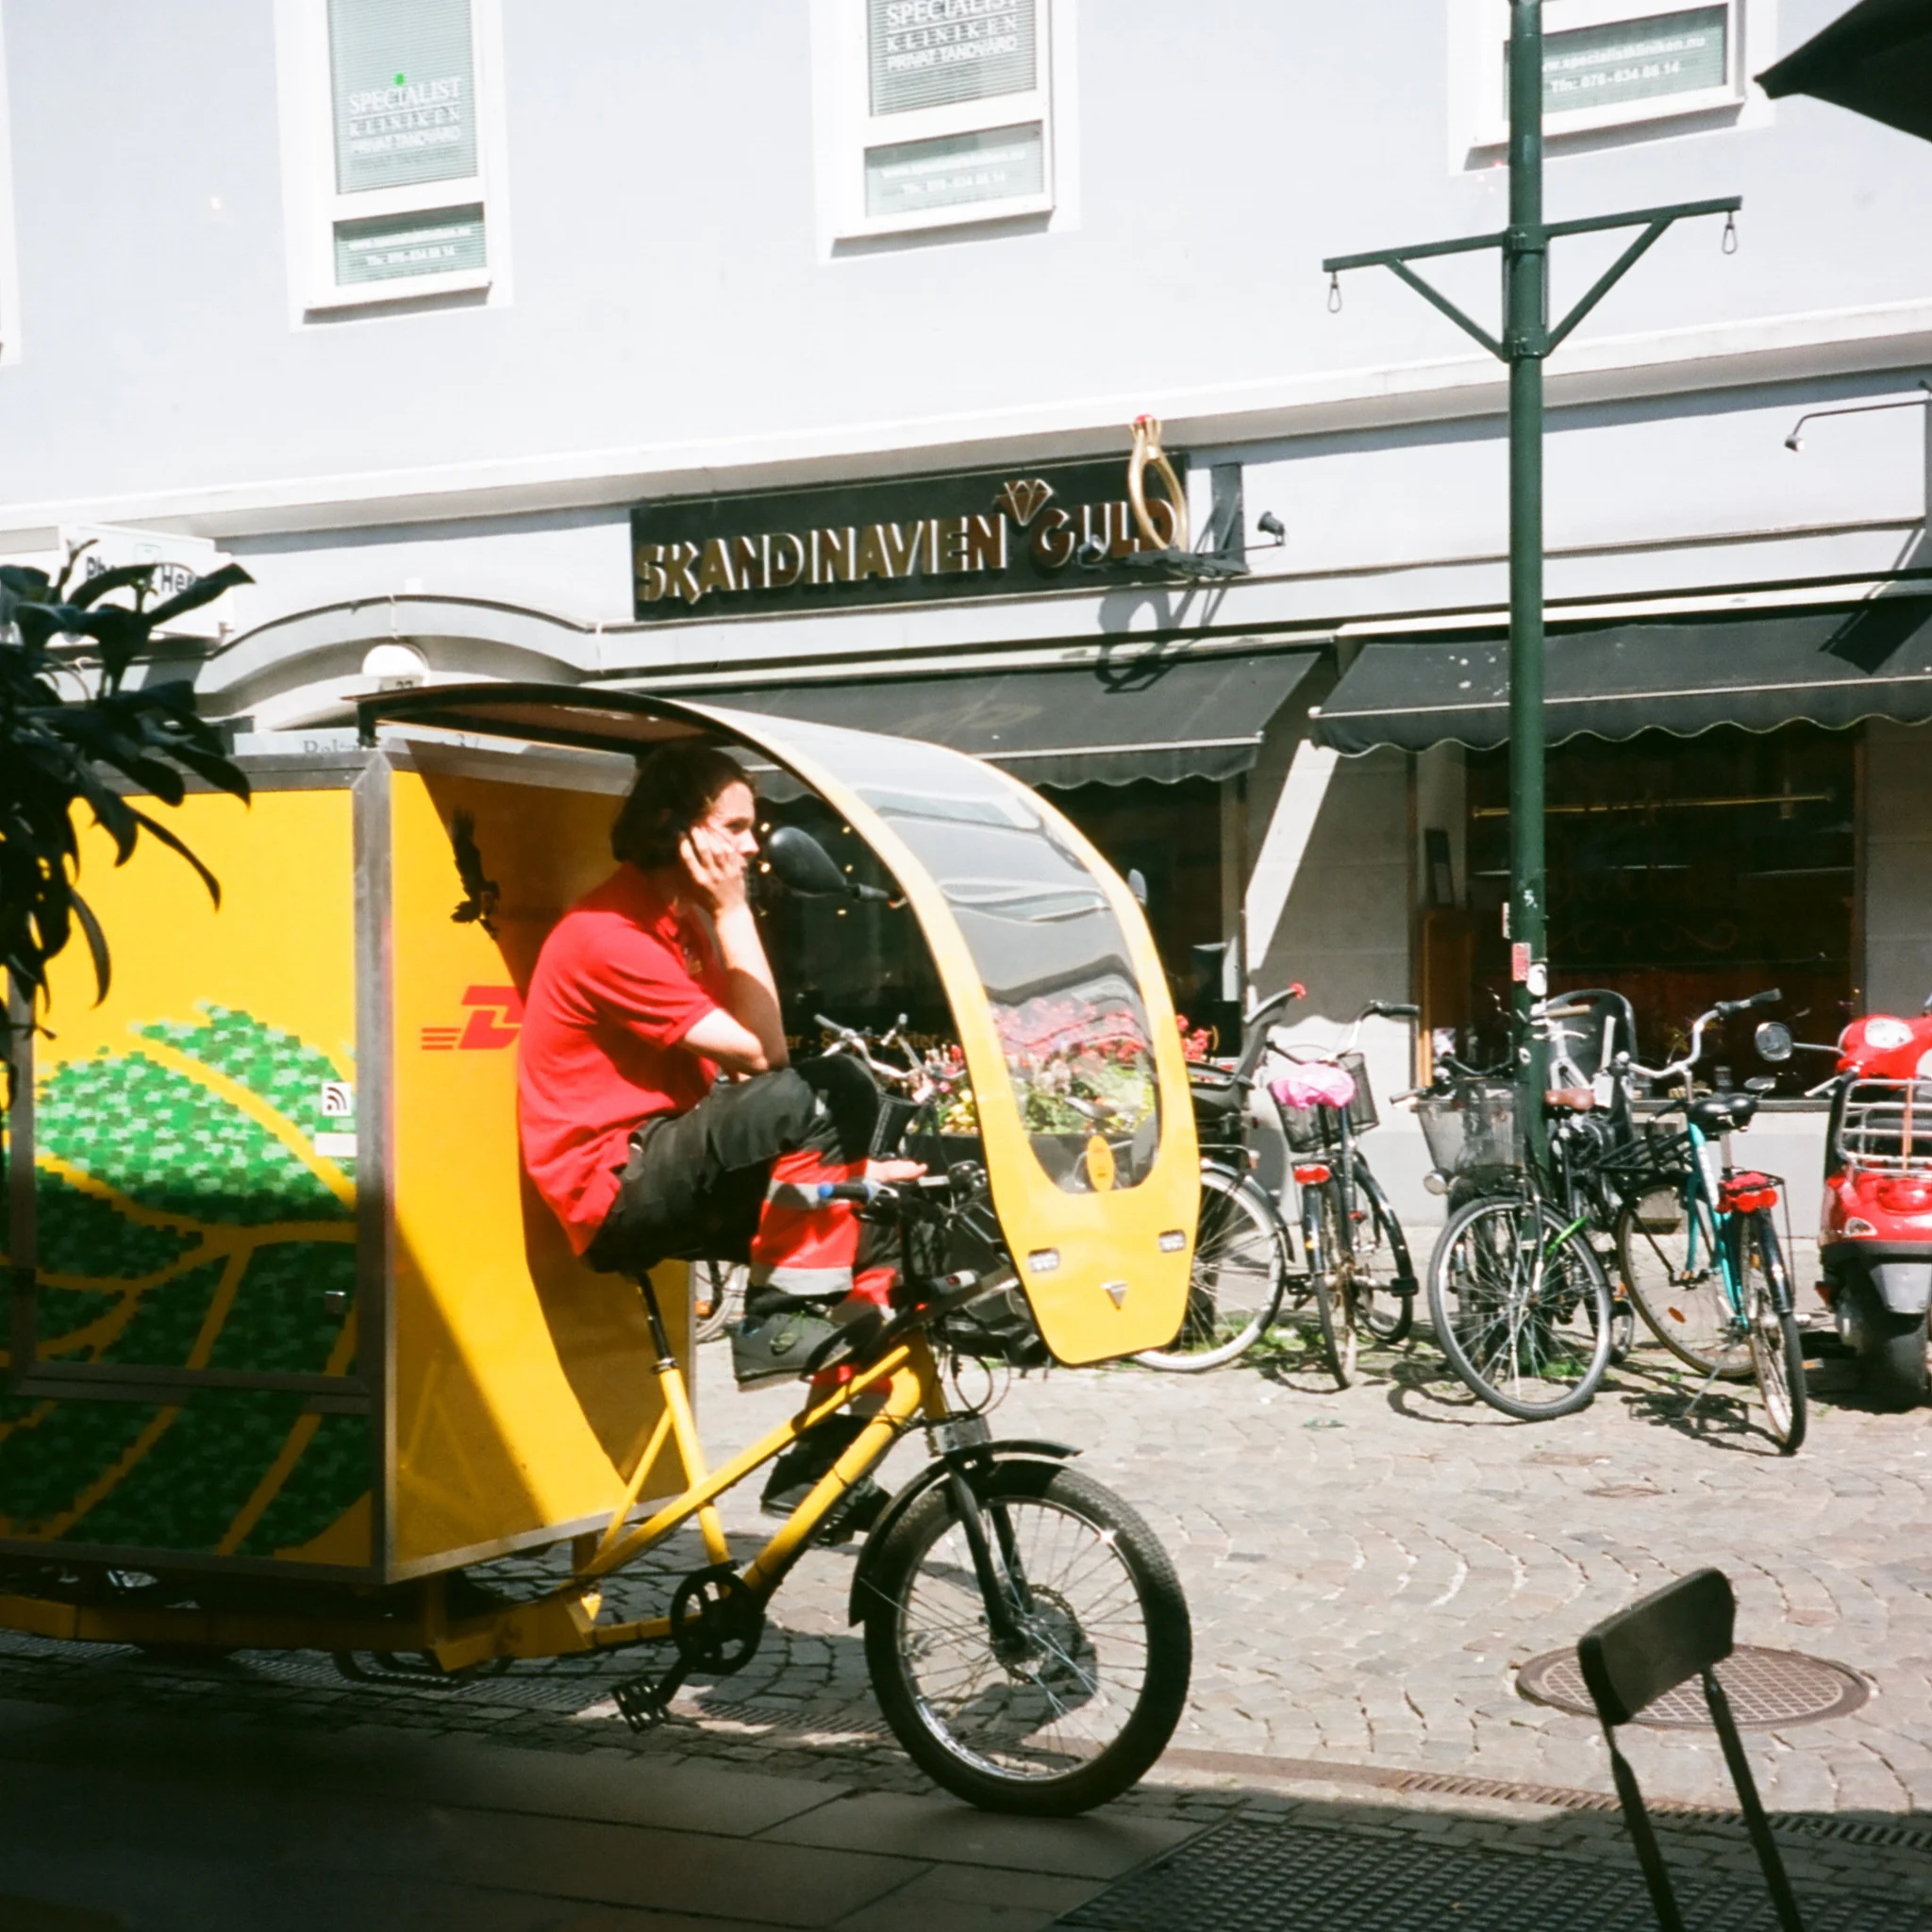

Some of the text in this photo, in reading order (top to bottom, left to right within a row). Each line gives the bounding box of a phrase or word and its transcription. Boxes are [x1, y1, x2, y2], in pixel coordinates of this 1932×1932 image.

[347, 76, 460, 115] SPECIALIST
[636, 498, 1177, 605] SKANDINAVIEN GULD
